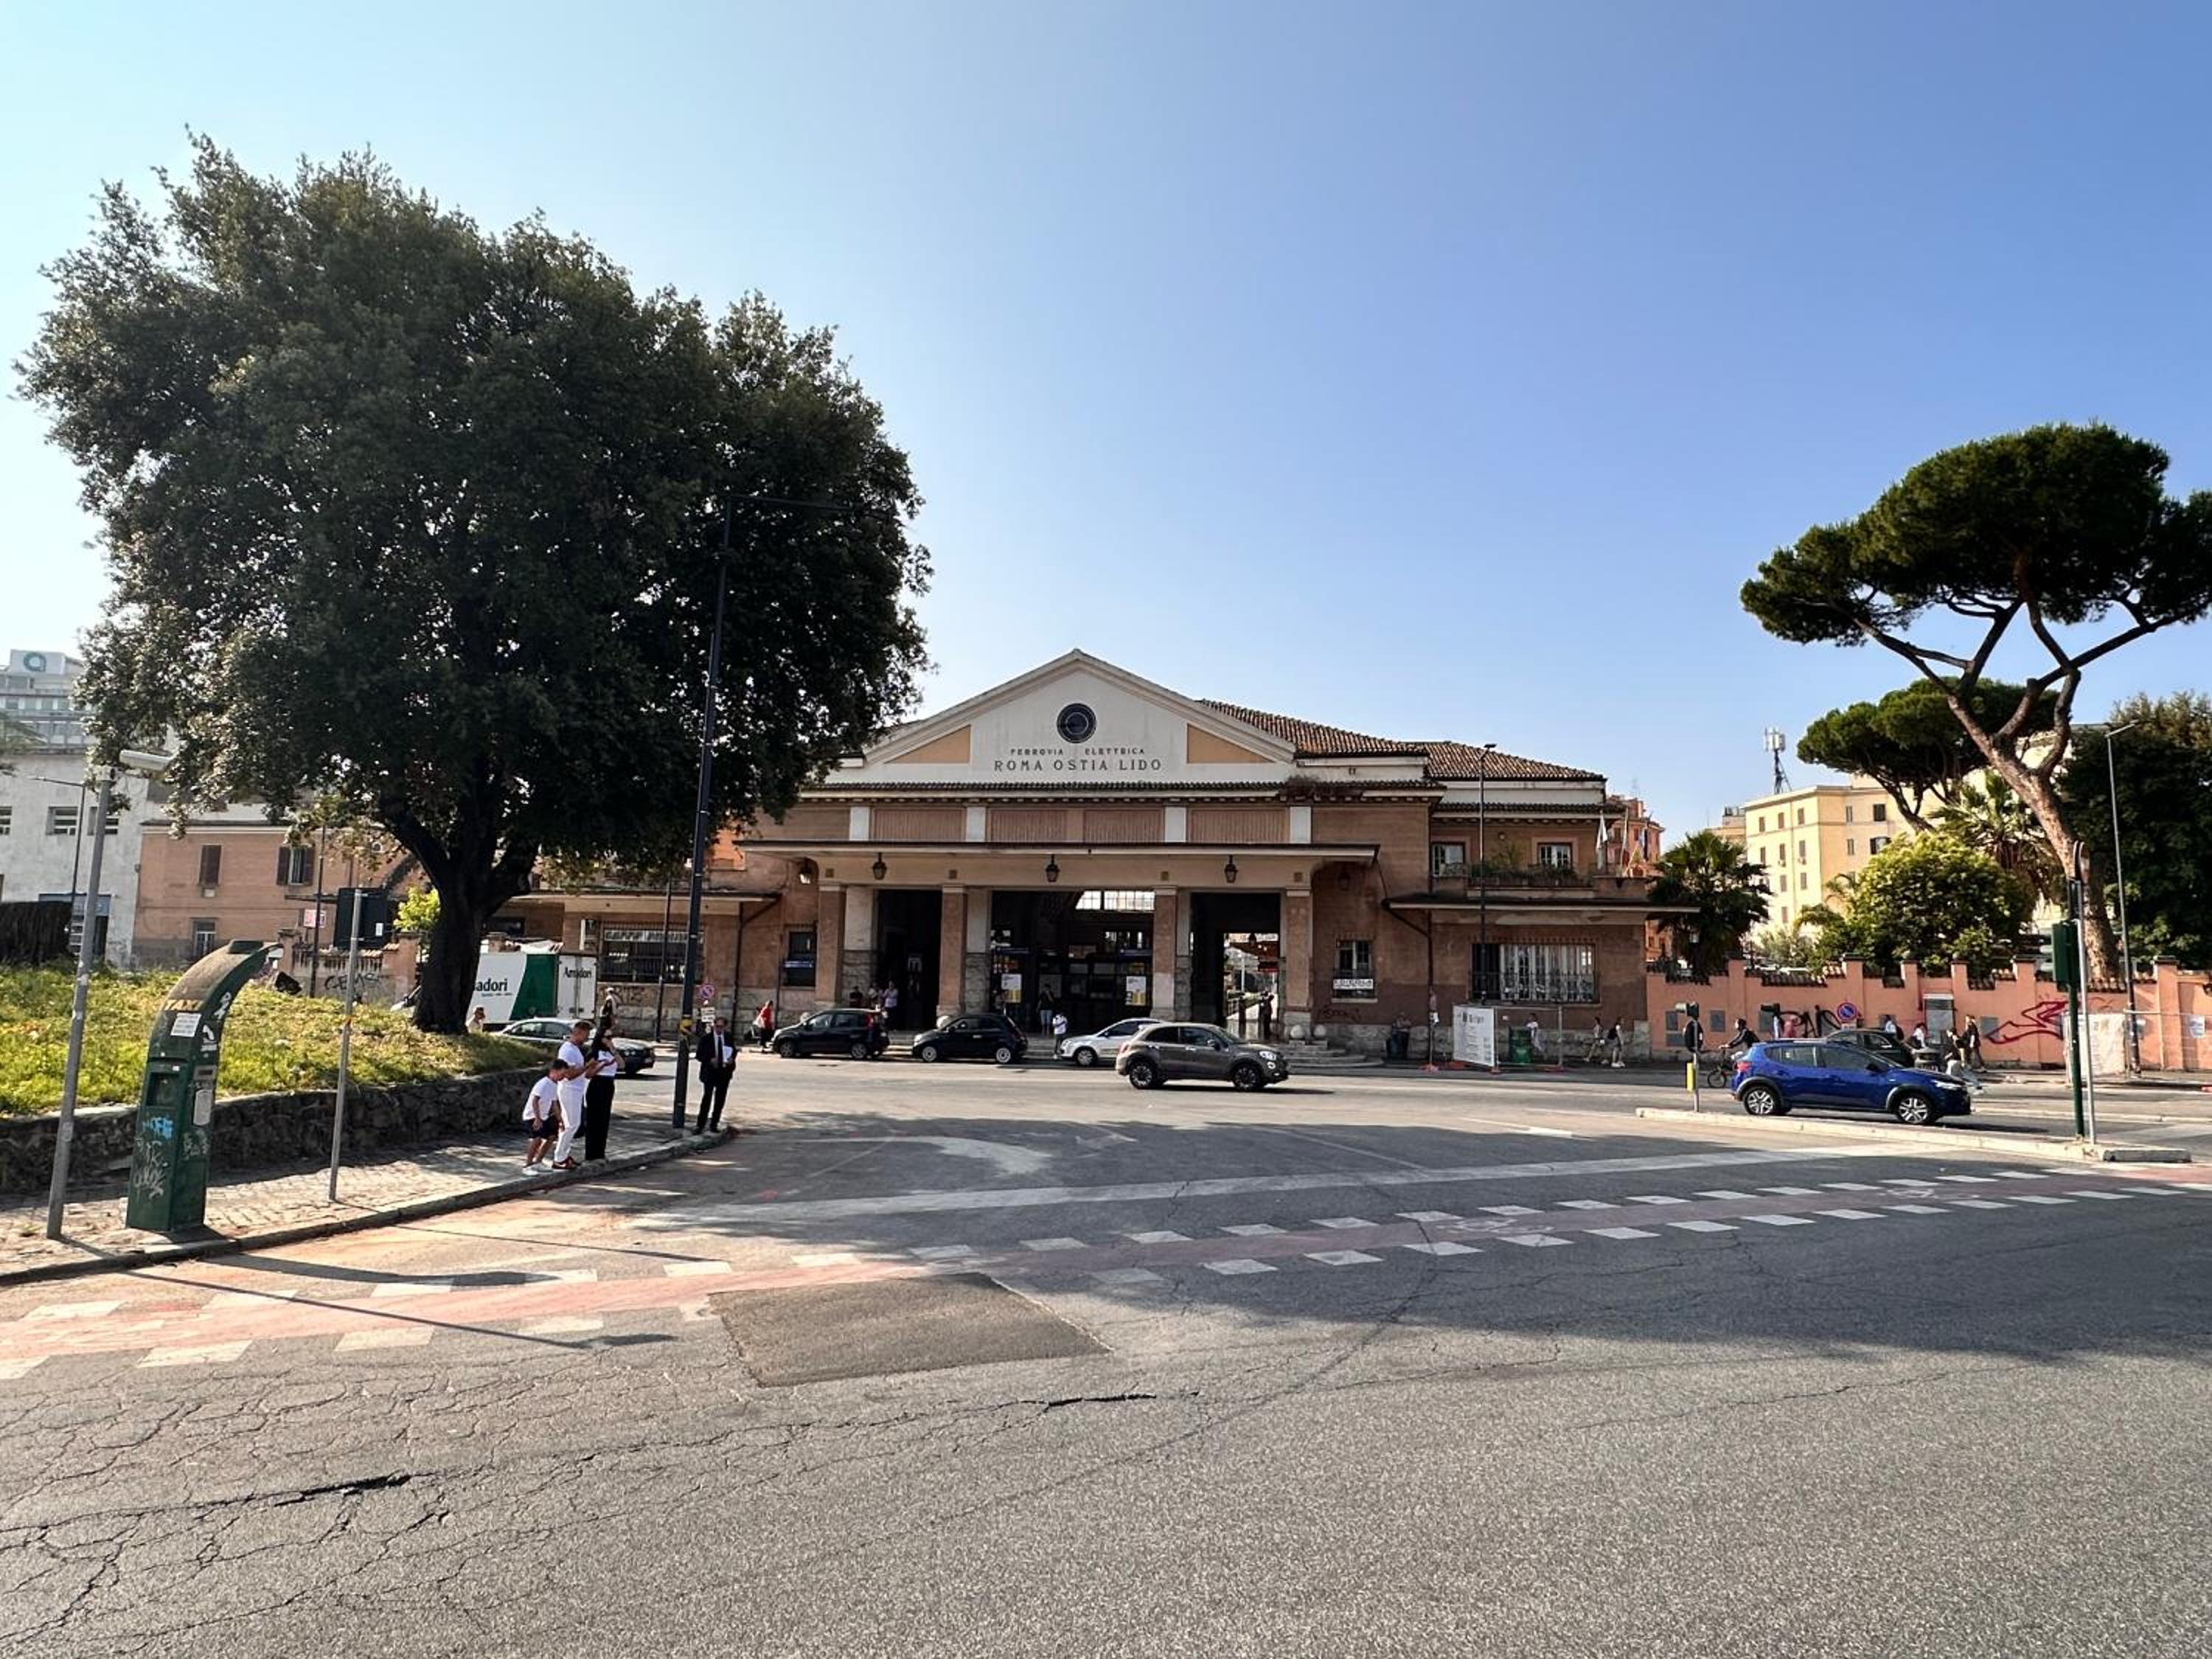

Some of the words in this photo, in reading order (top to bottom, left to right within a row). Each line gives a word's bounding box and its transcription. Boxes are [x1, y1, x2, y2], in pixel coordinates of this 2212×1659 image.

[1085, 747, 1145, 755] ELETTRICA
[994, 759, 1043, 771] ROMA
[1054, 759, 1108, 771] OSTIA
[1119, 759, 1162, 771] LIDO
[476, 978, 508, 992] adori
[164, 999, 204, 1011] TAXI
